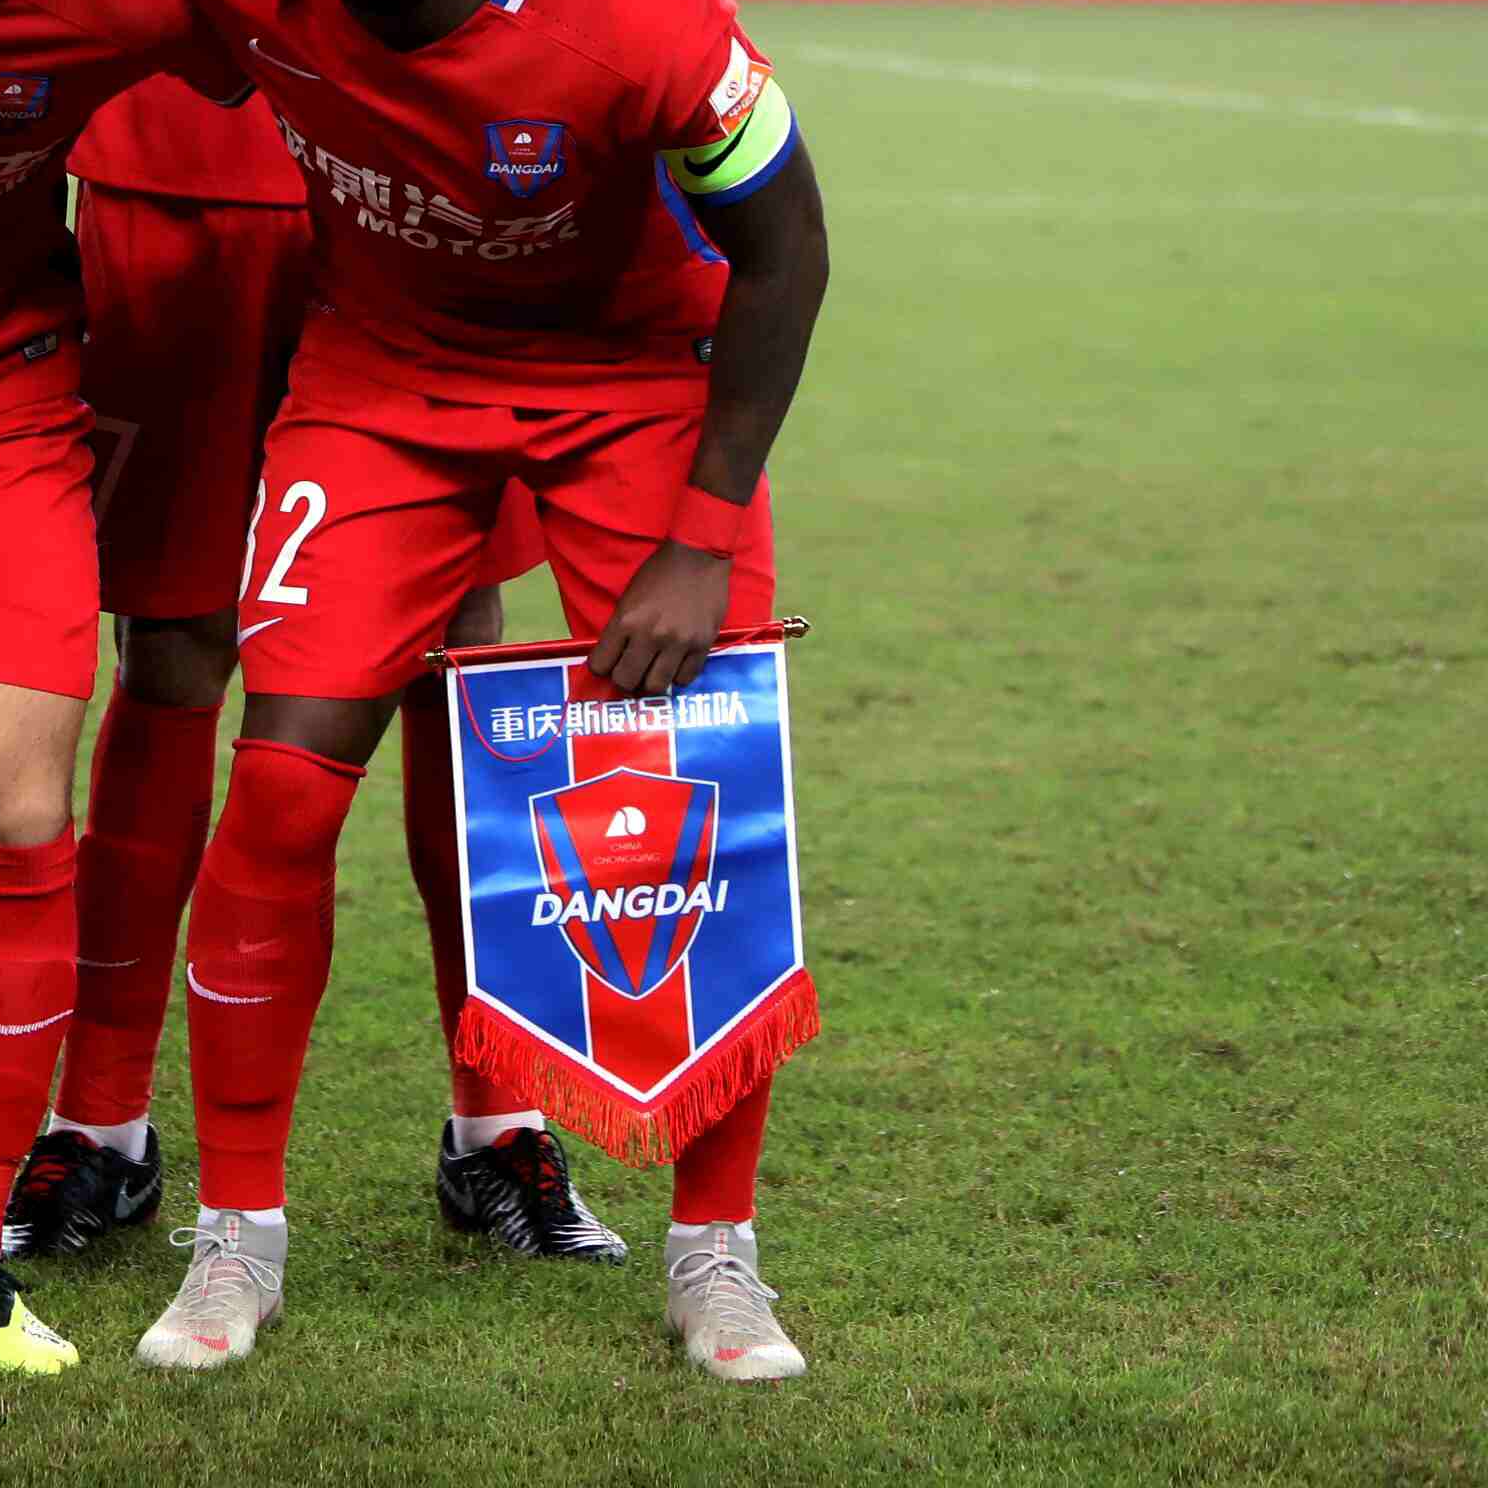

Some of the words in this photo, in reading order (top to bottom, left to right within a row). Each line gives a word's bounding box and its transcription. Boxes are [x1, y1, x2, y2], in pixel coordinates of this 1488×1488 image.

[488, 161, 559, 176] DANGDAI
[490, 690, 750, 743] 重庆斯威足球队
[530, 879, 730, 928] DANGDAI
